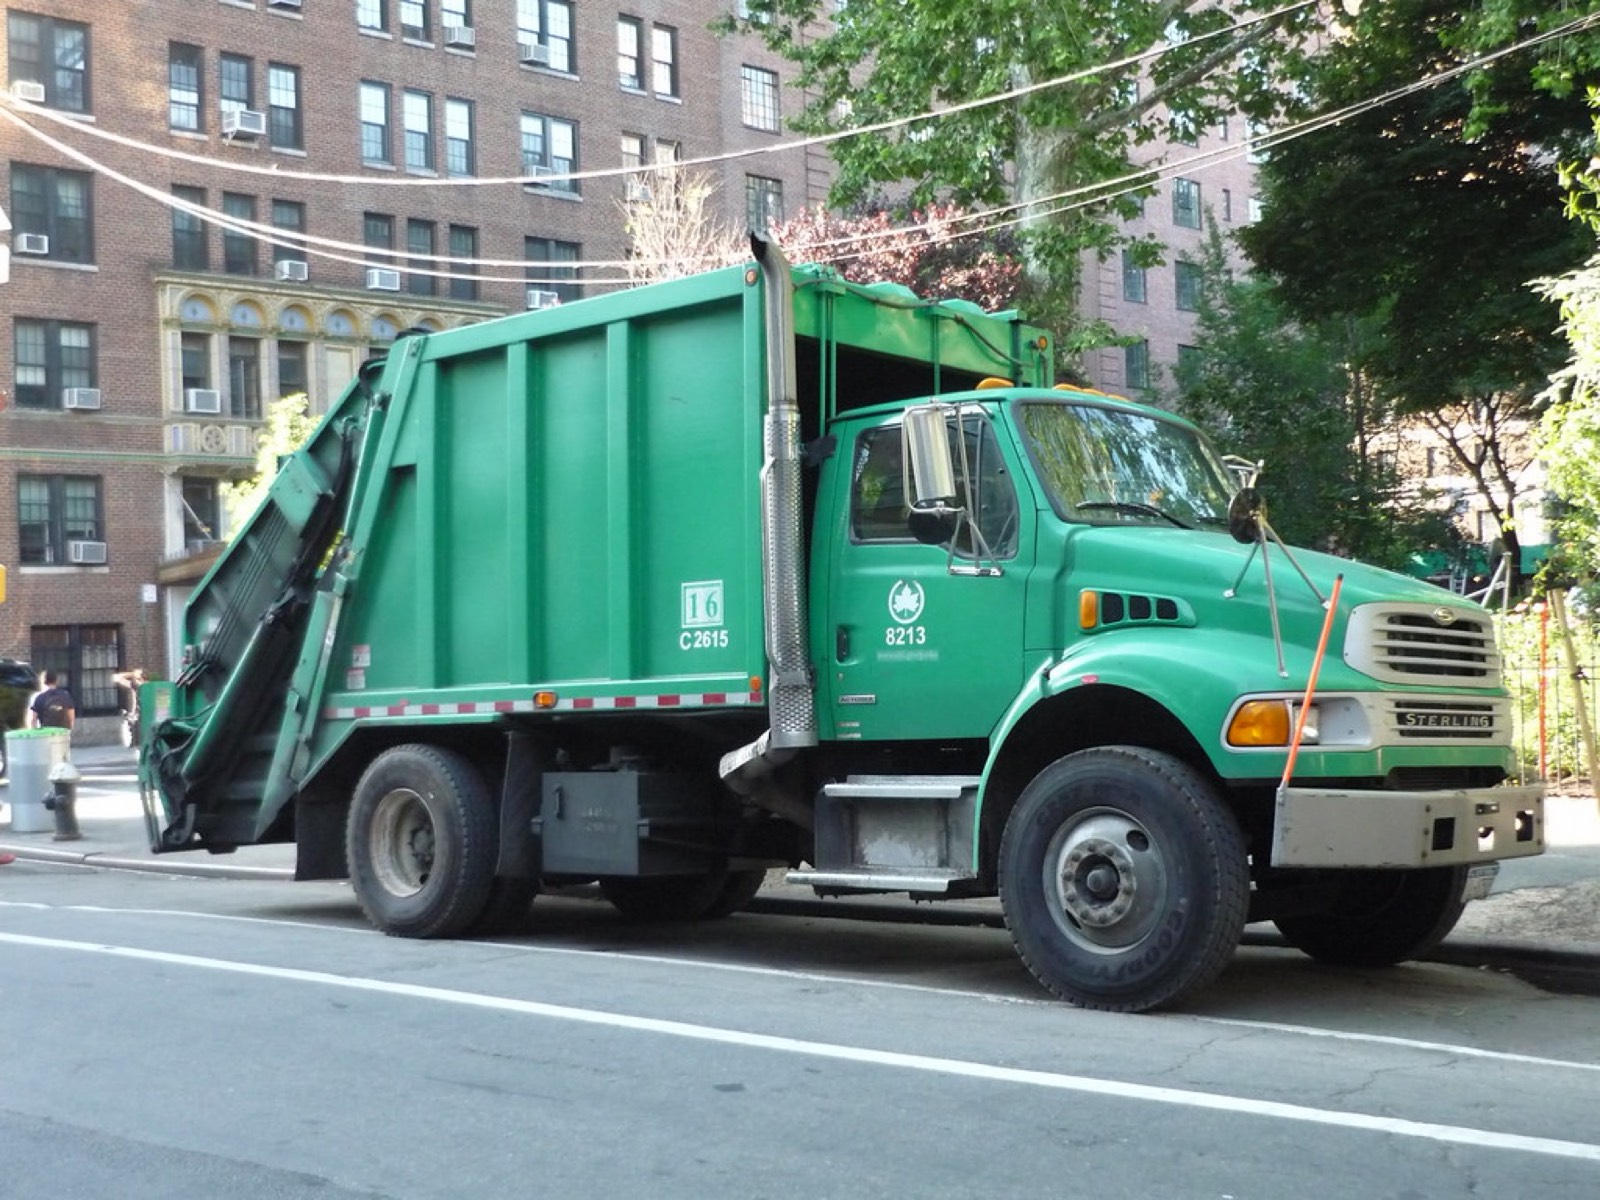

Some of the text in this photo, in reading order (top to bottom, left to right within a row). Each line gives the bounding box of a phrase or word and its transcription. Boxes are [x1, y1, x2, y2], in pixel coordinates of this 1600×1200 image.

[689, 590, 718, 618] 16
[886, 626, 926, 645] 8213
[1406, 713, 1490, 727] STERLING
